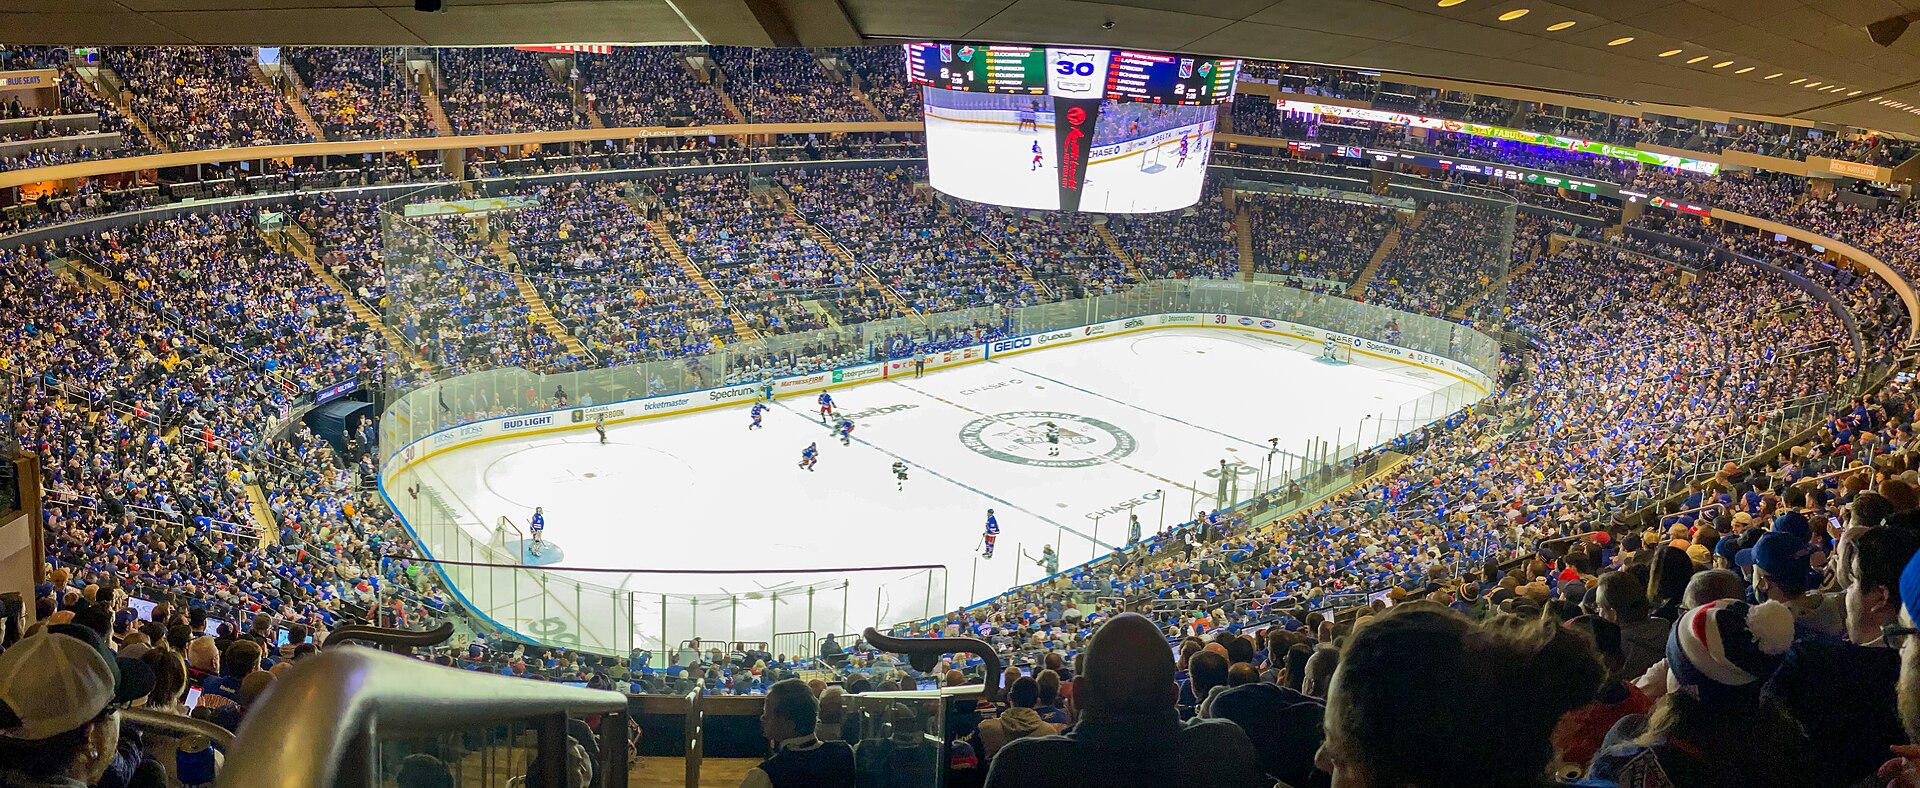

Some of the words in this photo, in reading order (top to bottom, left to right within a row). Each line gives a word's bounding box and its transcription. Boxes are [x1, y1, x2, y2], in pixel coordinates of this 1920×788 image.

[940, 67, 949, 78] 2
[967, 70, 974, 81] 1
[1056, 60, 1095, 77] 30
[8, 77, 21, 86] BLUE
[23, 75, 40, 85] SEATS
[1174, 83, 1185, 95] 2
[1201, 85, 1207, 96] 1
[1155, 132, 1172, 142] DELTA
[1472, 126, 1492, 136] STAY
[1494, 129, 1537, 142] FABULOUS
[1494, 168, 1503, 177] 2
[1518, 173, 1524, 181] 1
[1215, 314, 1227, 324] 30
[994, 337, 1031, 352] GEICO
[1366, 341, 1399, 355] Spectrum
[1417, 353, 1445, 366] DELTA
[709, 387, 752, 401] Spectrum
[644, 398, 689, 411] ticketmaster
[503, 420, 523, 430] BUD
[524, 416, 552, 427] LIGHT
[405, 445, 416, 463] 30
[1085, 497, 1147, 520] CHASE
